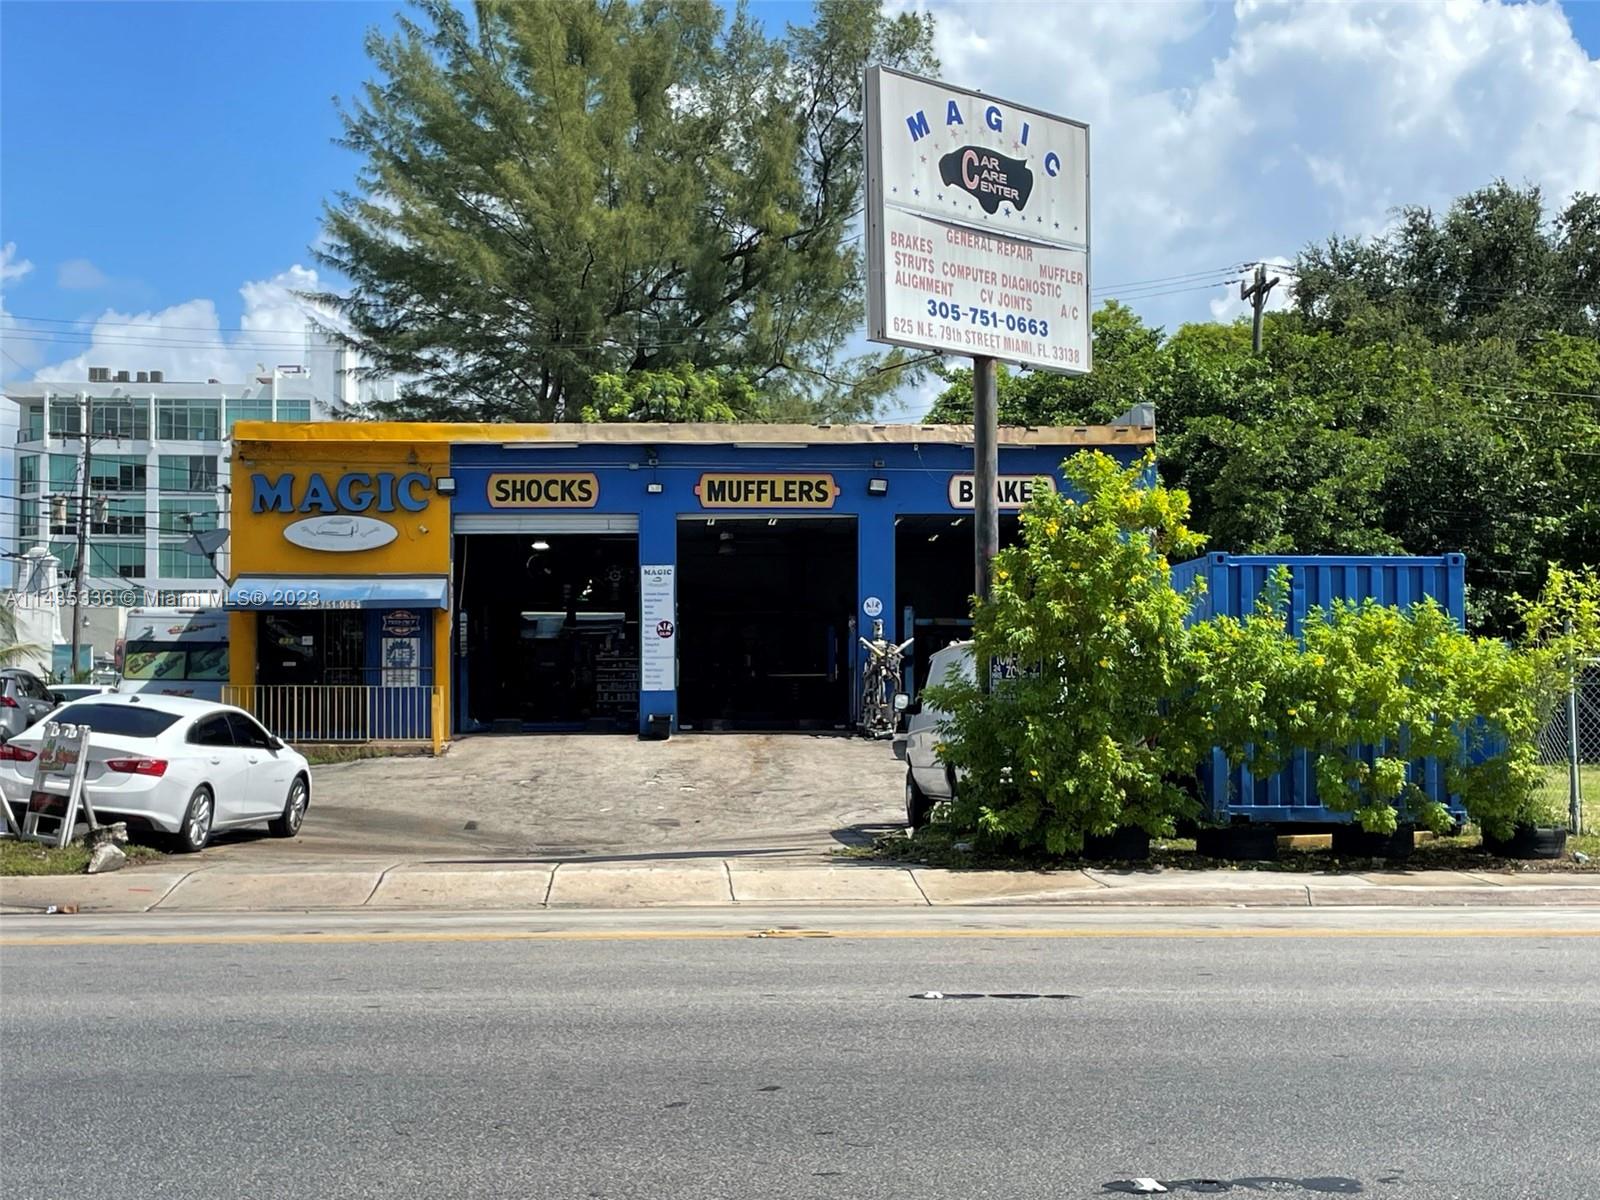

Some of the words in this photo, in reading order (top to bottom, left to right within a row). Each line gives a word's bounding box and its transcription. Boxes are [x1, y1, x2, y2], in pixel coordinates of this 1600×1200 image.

[906, 100, 1061, 177] MAGIC
[890, 231, 934, 254] BRAKES
[946, 229, 993, 252] GENERAL
[997, 240, 1034, 262] REPAIR
[894, 252, 935, 274] STRUTS
[942, 262, 998, 286] COMPUTER
[1001, 273, 1062, 299] DIAGNOSTIC
[895, 270, 954, 297] ALIGNMENT
[1039, 264, 1084, 286] MUFFLER
[980, 288, 994, 303] CV
[998, 293, 1033, 312] JOINTS
[927, 298, 1049, 338] 305-751-0663
[1060, 304, 1079, 321] A/C
[893, 316, 914, 334] 625
[940, 324, 962, 342] 79th
[964, 329, 1001, 350] STREET
[1052, 345, 1080, 364] 33138
[250, 472, 432, 514] MAGIC
[495, 479, 593, 502] SHOCKS
[706, 479, 830, 503] MUFFLERS
[959, 480, 1048, 502] BKE
[643, 568, 673, 576] MAGIC
